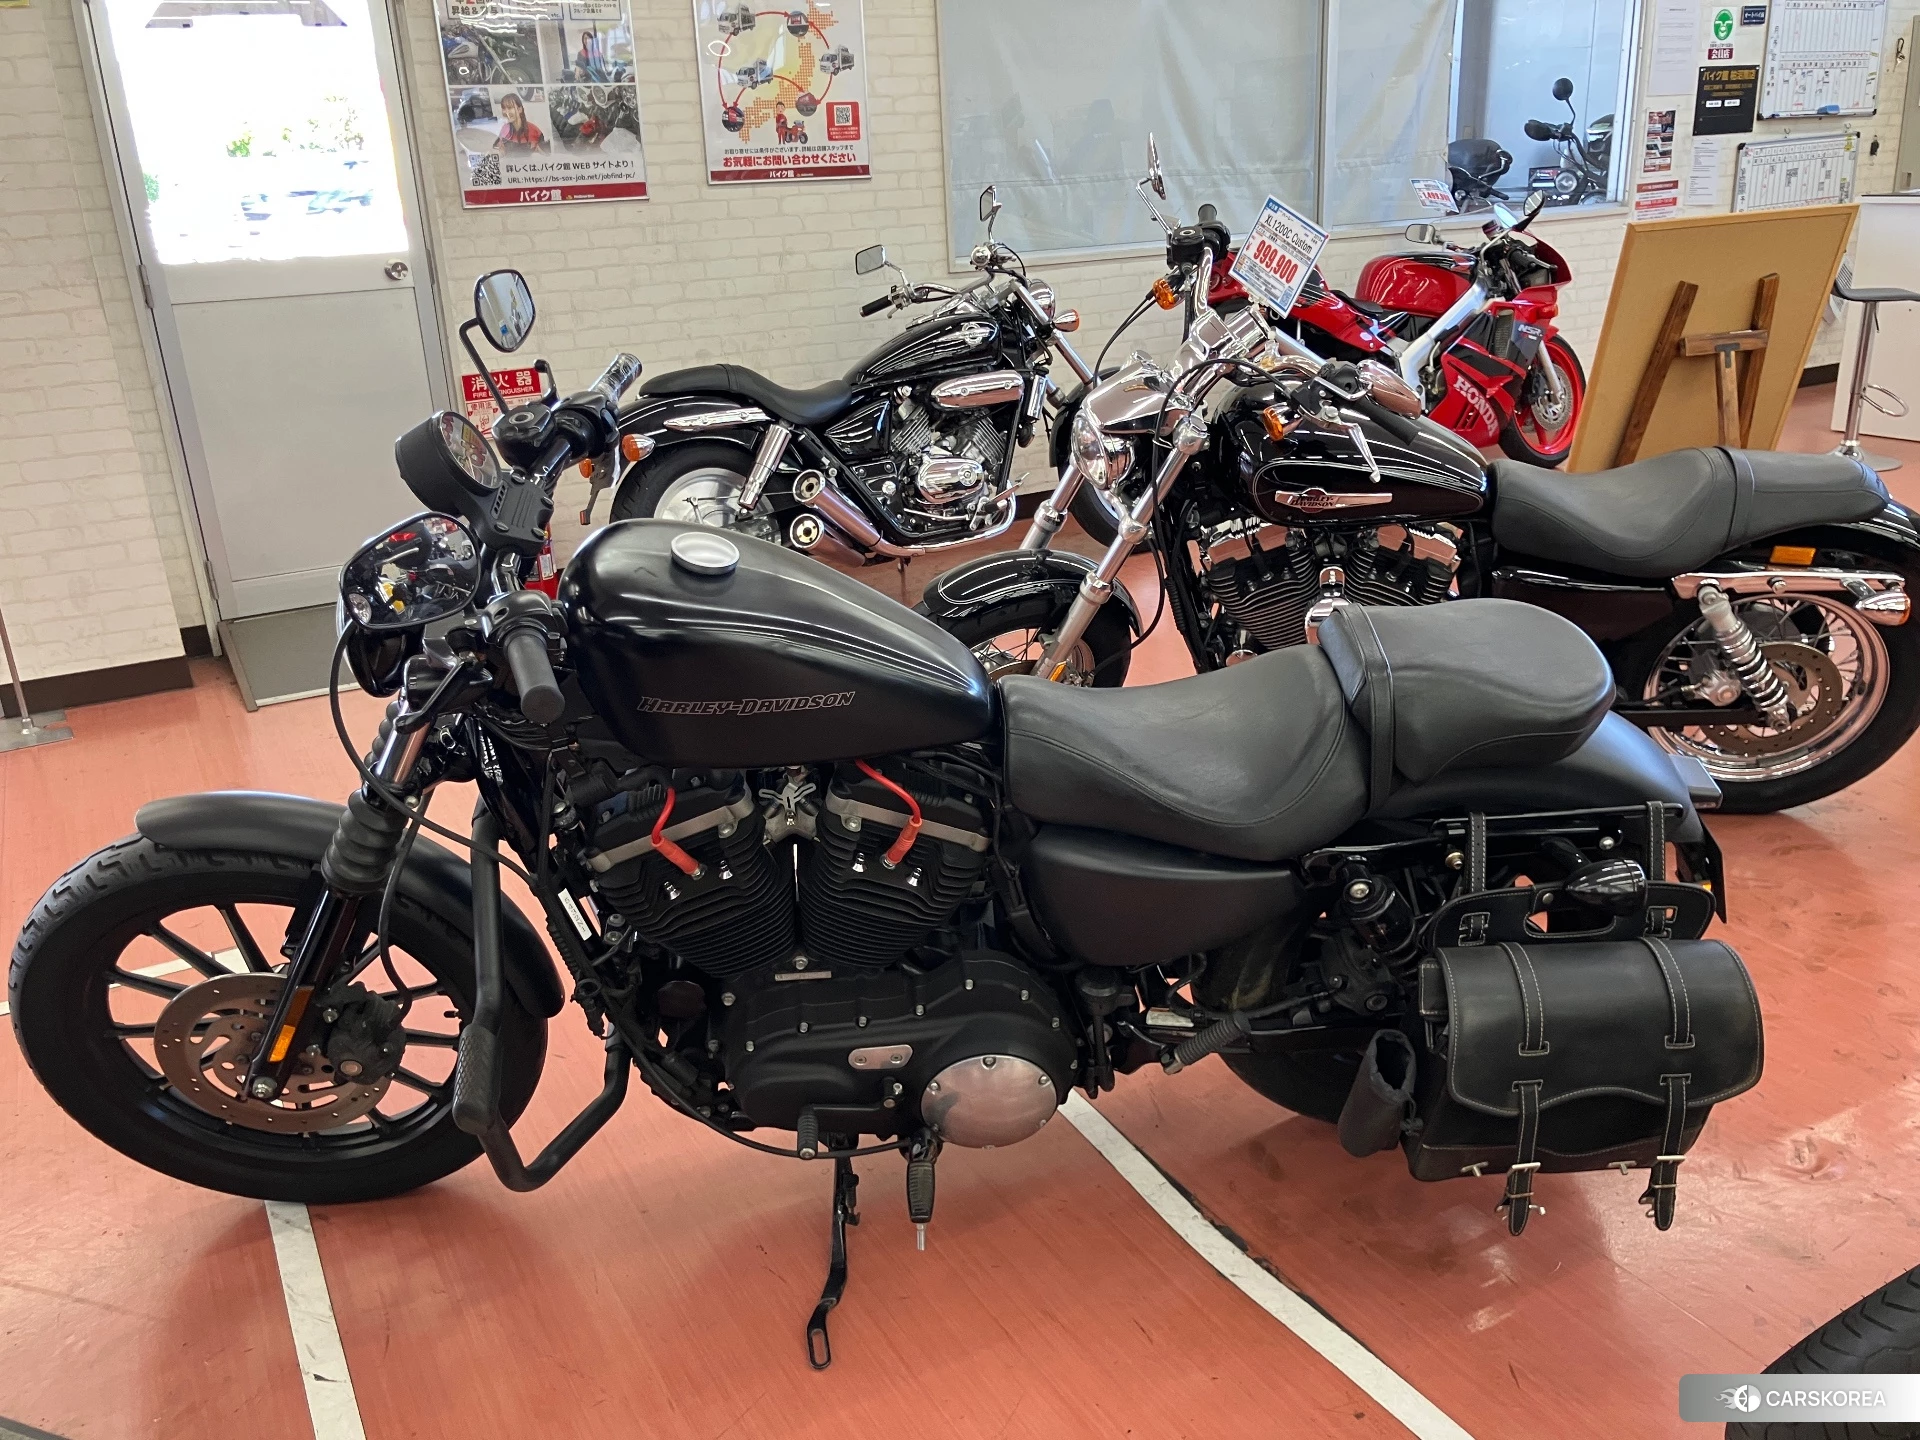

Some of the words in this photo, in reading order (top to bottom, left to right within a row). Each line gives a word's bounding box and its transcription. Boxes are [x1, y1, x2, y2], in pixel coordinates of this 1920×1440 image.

[572, 162, 591, 170] WEB
[722, 153, 857, 168] お気軽にお問い合わせください
[1264, 213, 1293, 240] XL1200C
[1291, 233, 1313, 254] Custom
[1253, 239, 1299, 285] 999,900
[471, 370, 532, 392] 消火器
[472, 391, 488, 399] FIRE
[1453, 375, 1500, 437] HONDA
[636, 690, 856, 716] HARLEY-DAVIDSON
